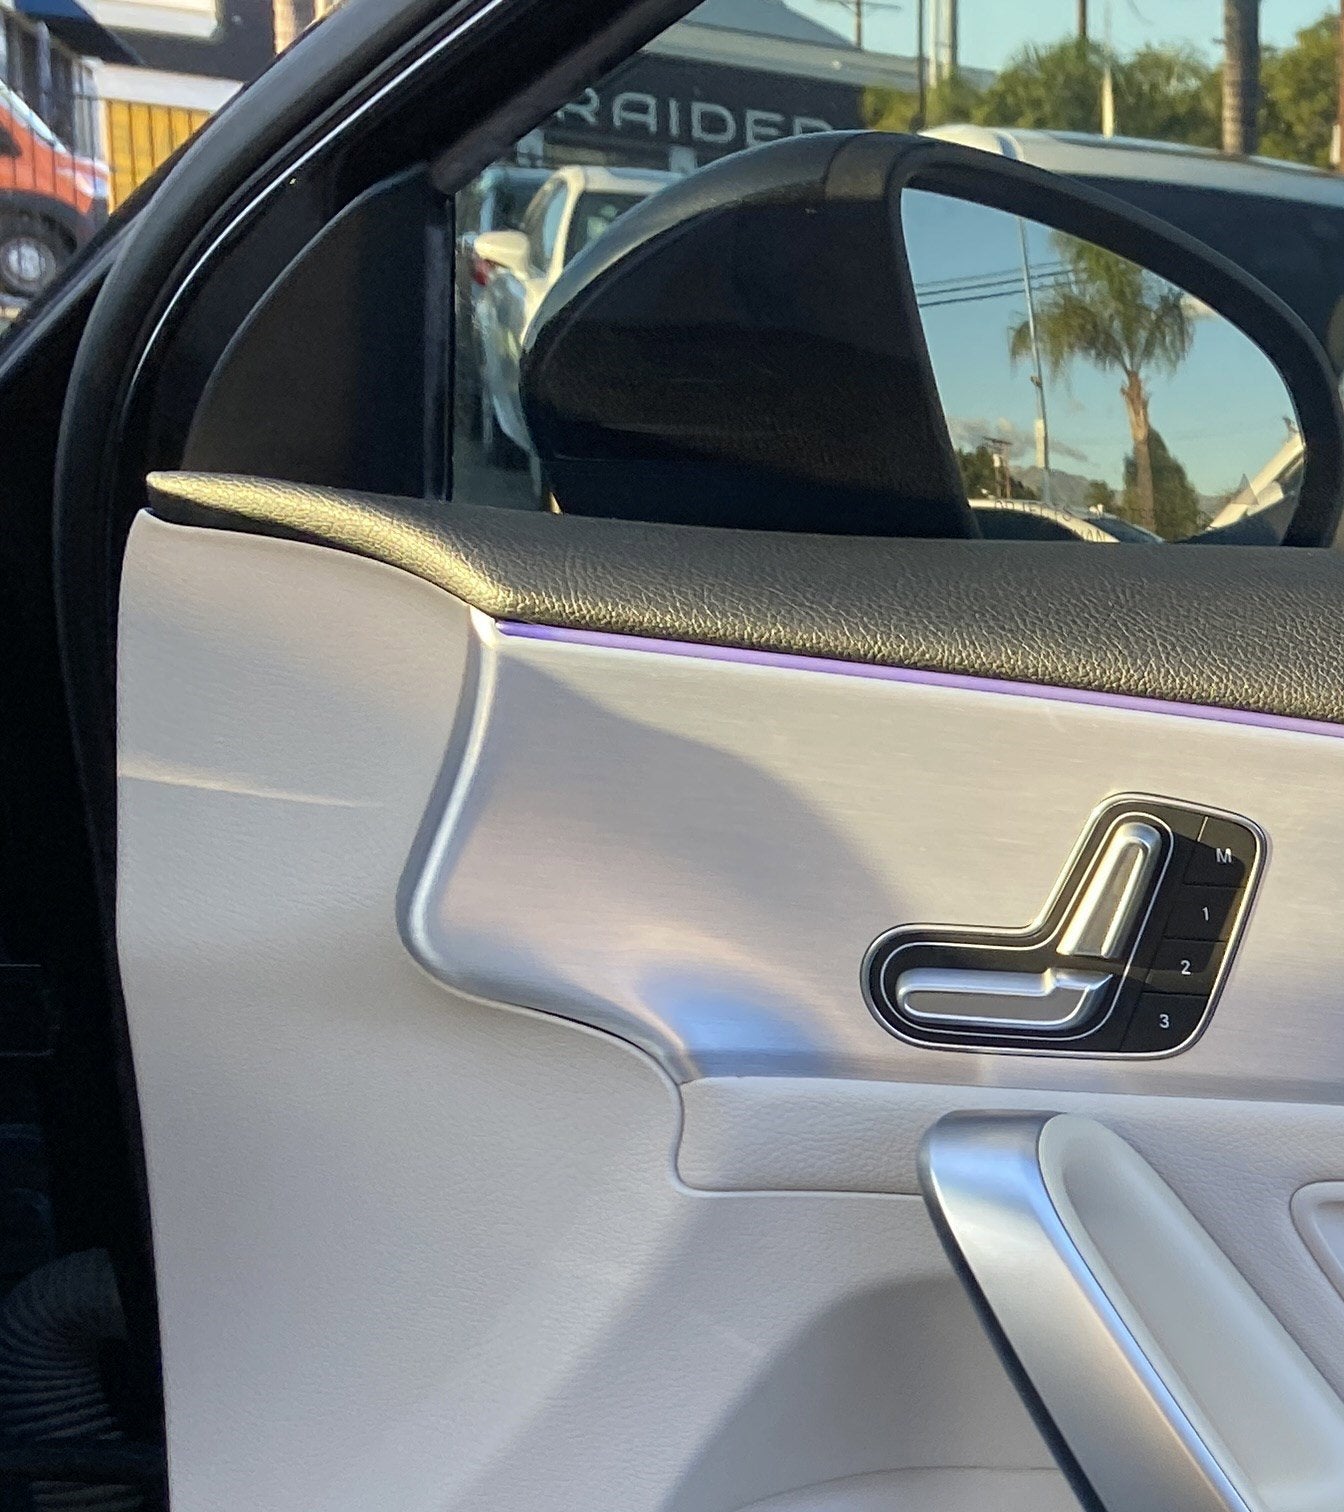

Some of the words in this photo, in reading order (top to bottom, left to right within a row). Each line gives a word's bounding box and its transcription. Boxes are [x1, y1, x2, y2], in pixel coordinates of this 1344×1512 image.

[1216, 848, 1232, 863] M
[1202, 906, 1210, 921] 1
[1180, 960, 1191, 975] 2
[1159, 1014, 1170, 1029] 3
